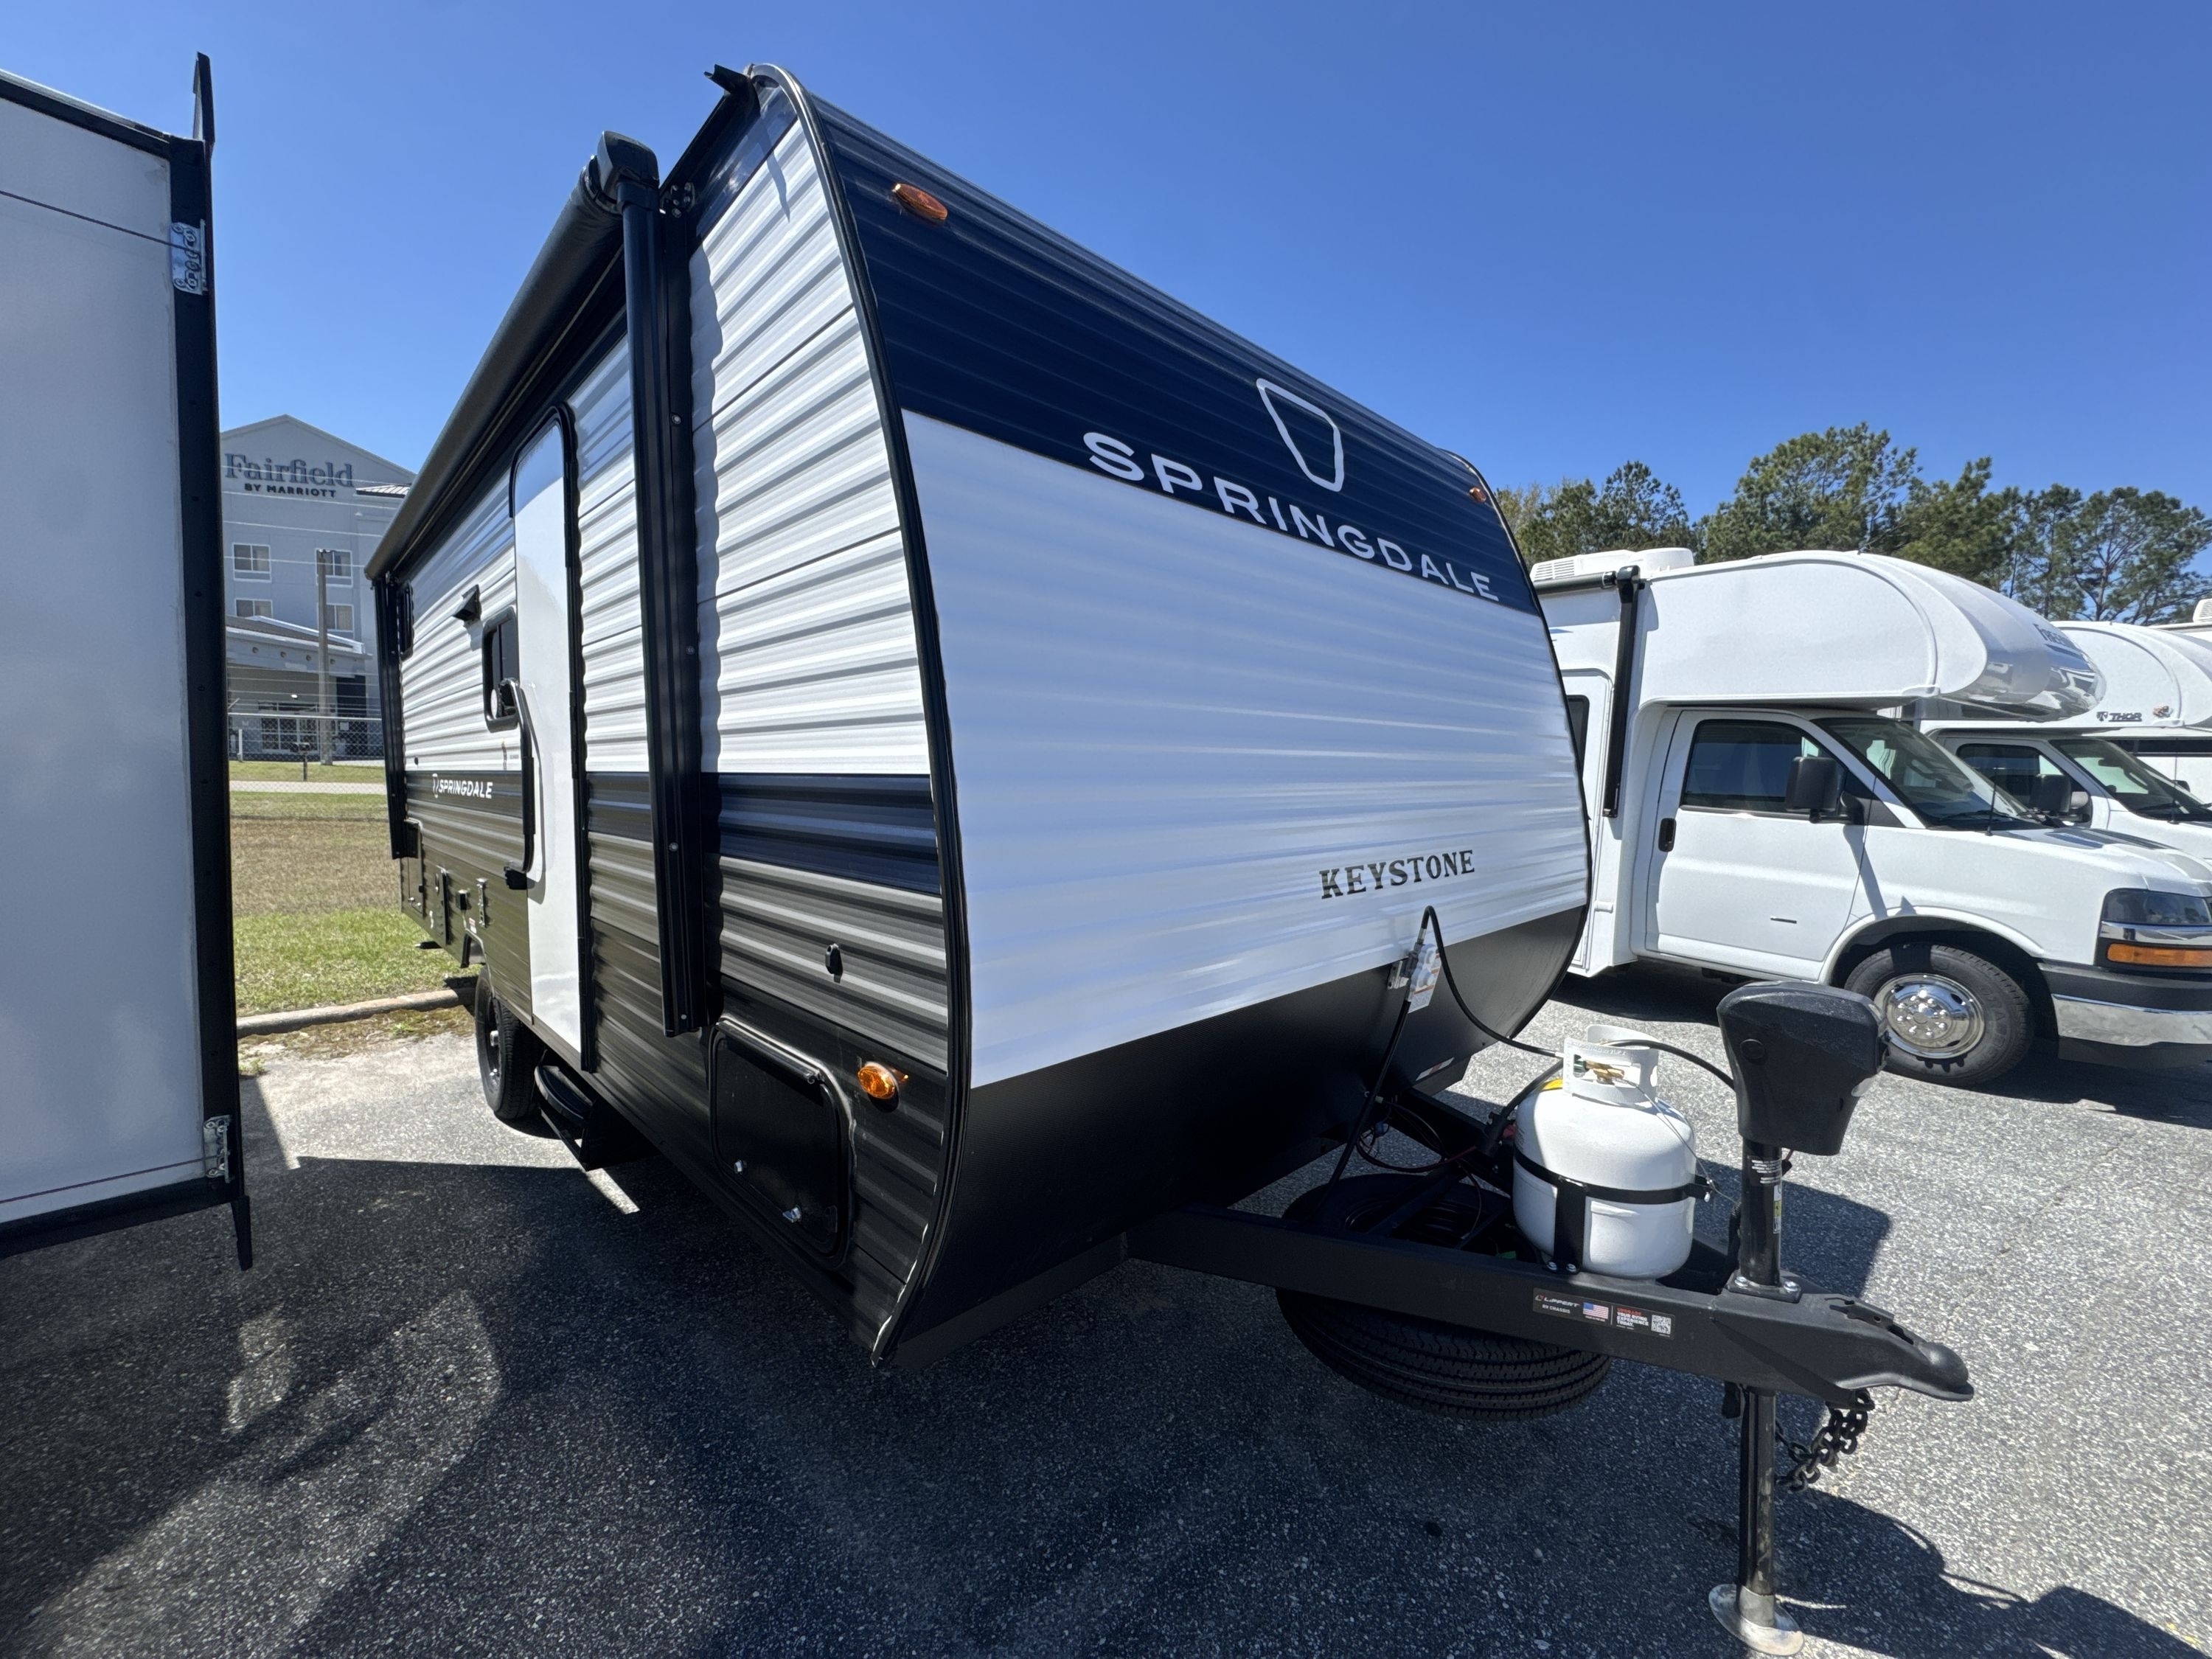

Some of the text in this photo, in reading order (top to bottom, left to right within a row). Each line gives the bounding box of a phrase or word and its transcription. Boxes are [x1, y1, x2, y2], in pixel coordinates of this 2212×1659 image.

[224, 453, 354, 488] Fairfield
[244, 483, 336, 498] BY MARRIOTT
[1083, 432, 1499, 602] SPRINGDALE
[2109, 712, 2142, 721] THOR
[438, 779, 493, 799] SPRINGDALE
[1319, 849, 1475, 900] KEYSTONE
